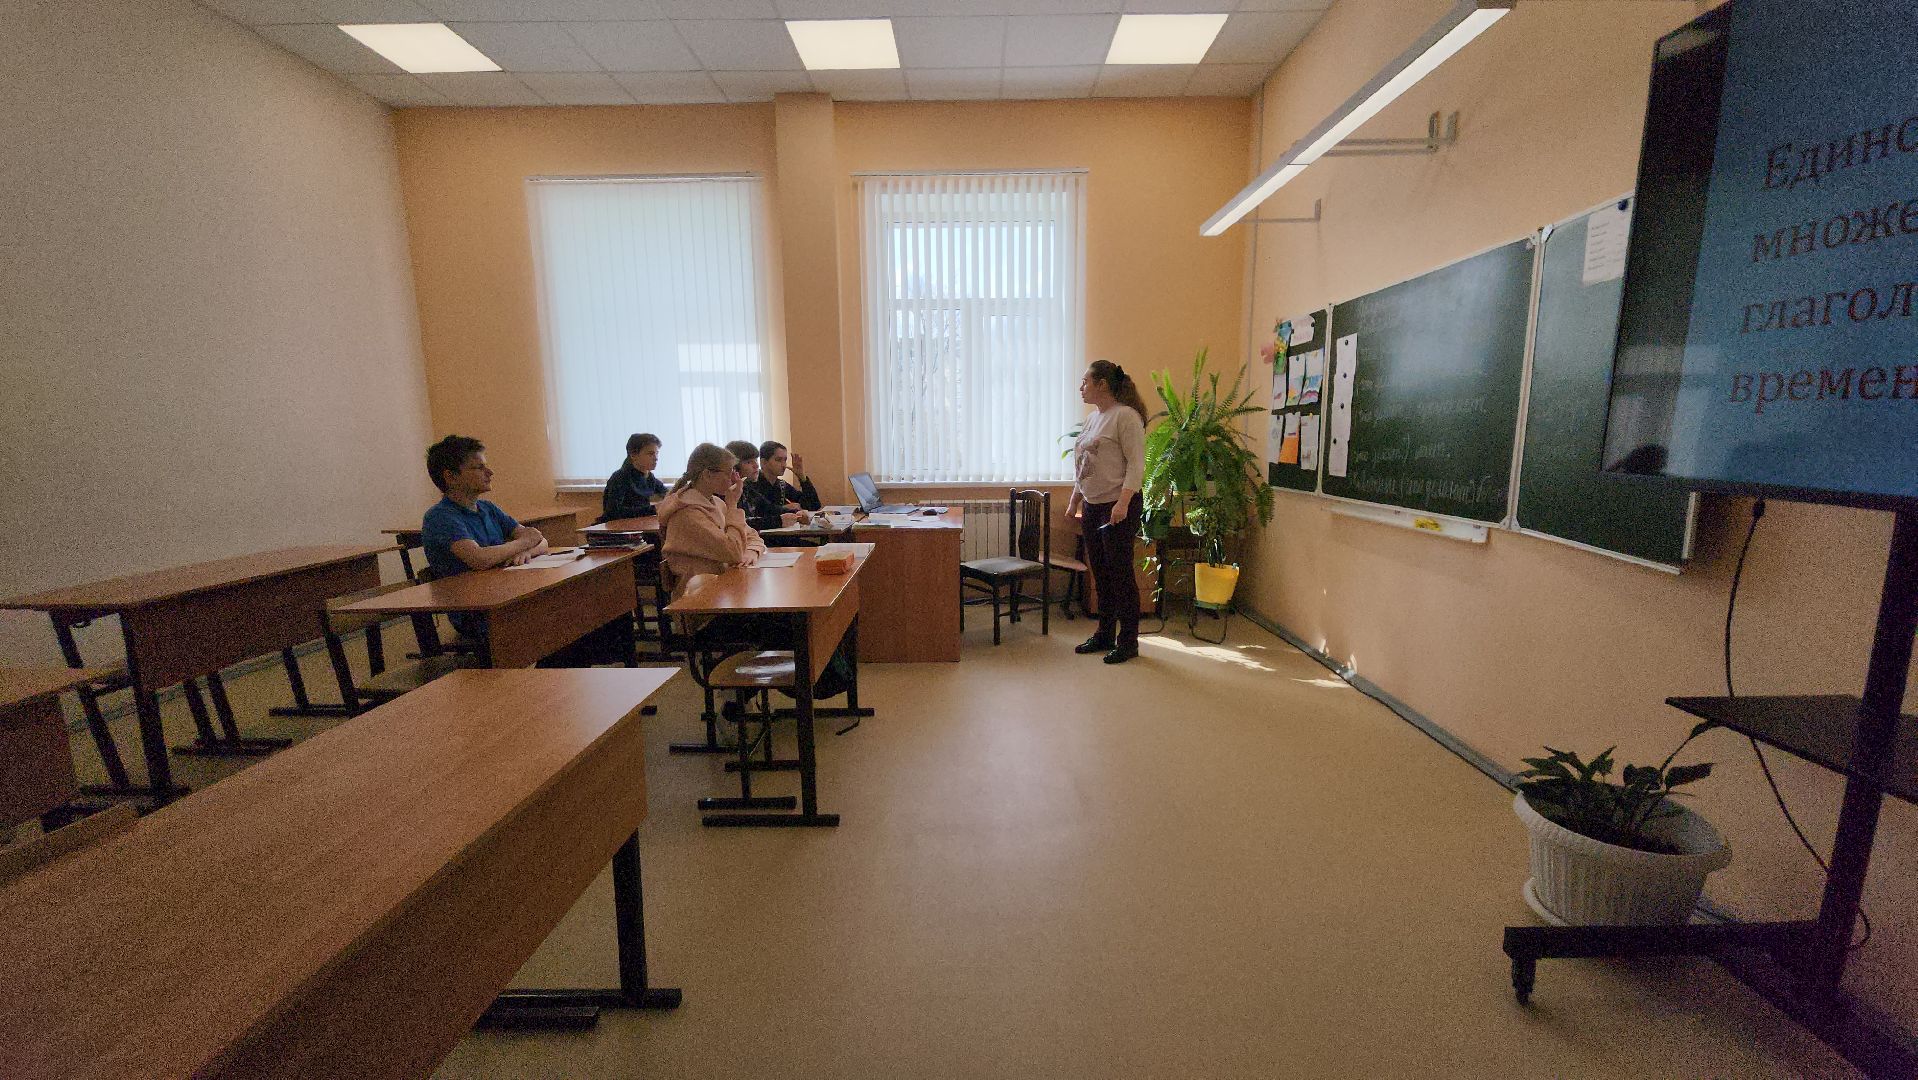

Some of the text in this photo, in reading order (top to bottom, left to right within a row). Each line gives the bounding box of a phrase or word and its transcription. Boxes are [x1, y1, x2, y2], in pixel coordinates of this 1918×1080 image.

[1752, 198, 1918, 263] множе
[1739, 282, 1917, 335] глагол
[1730, 365, 1918, 415] времен
